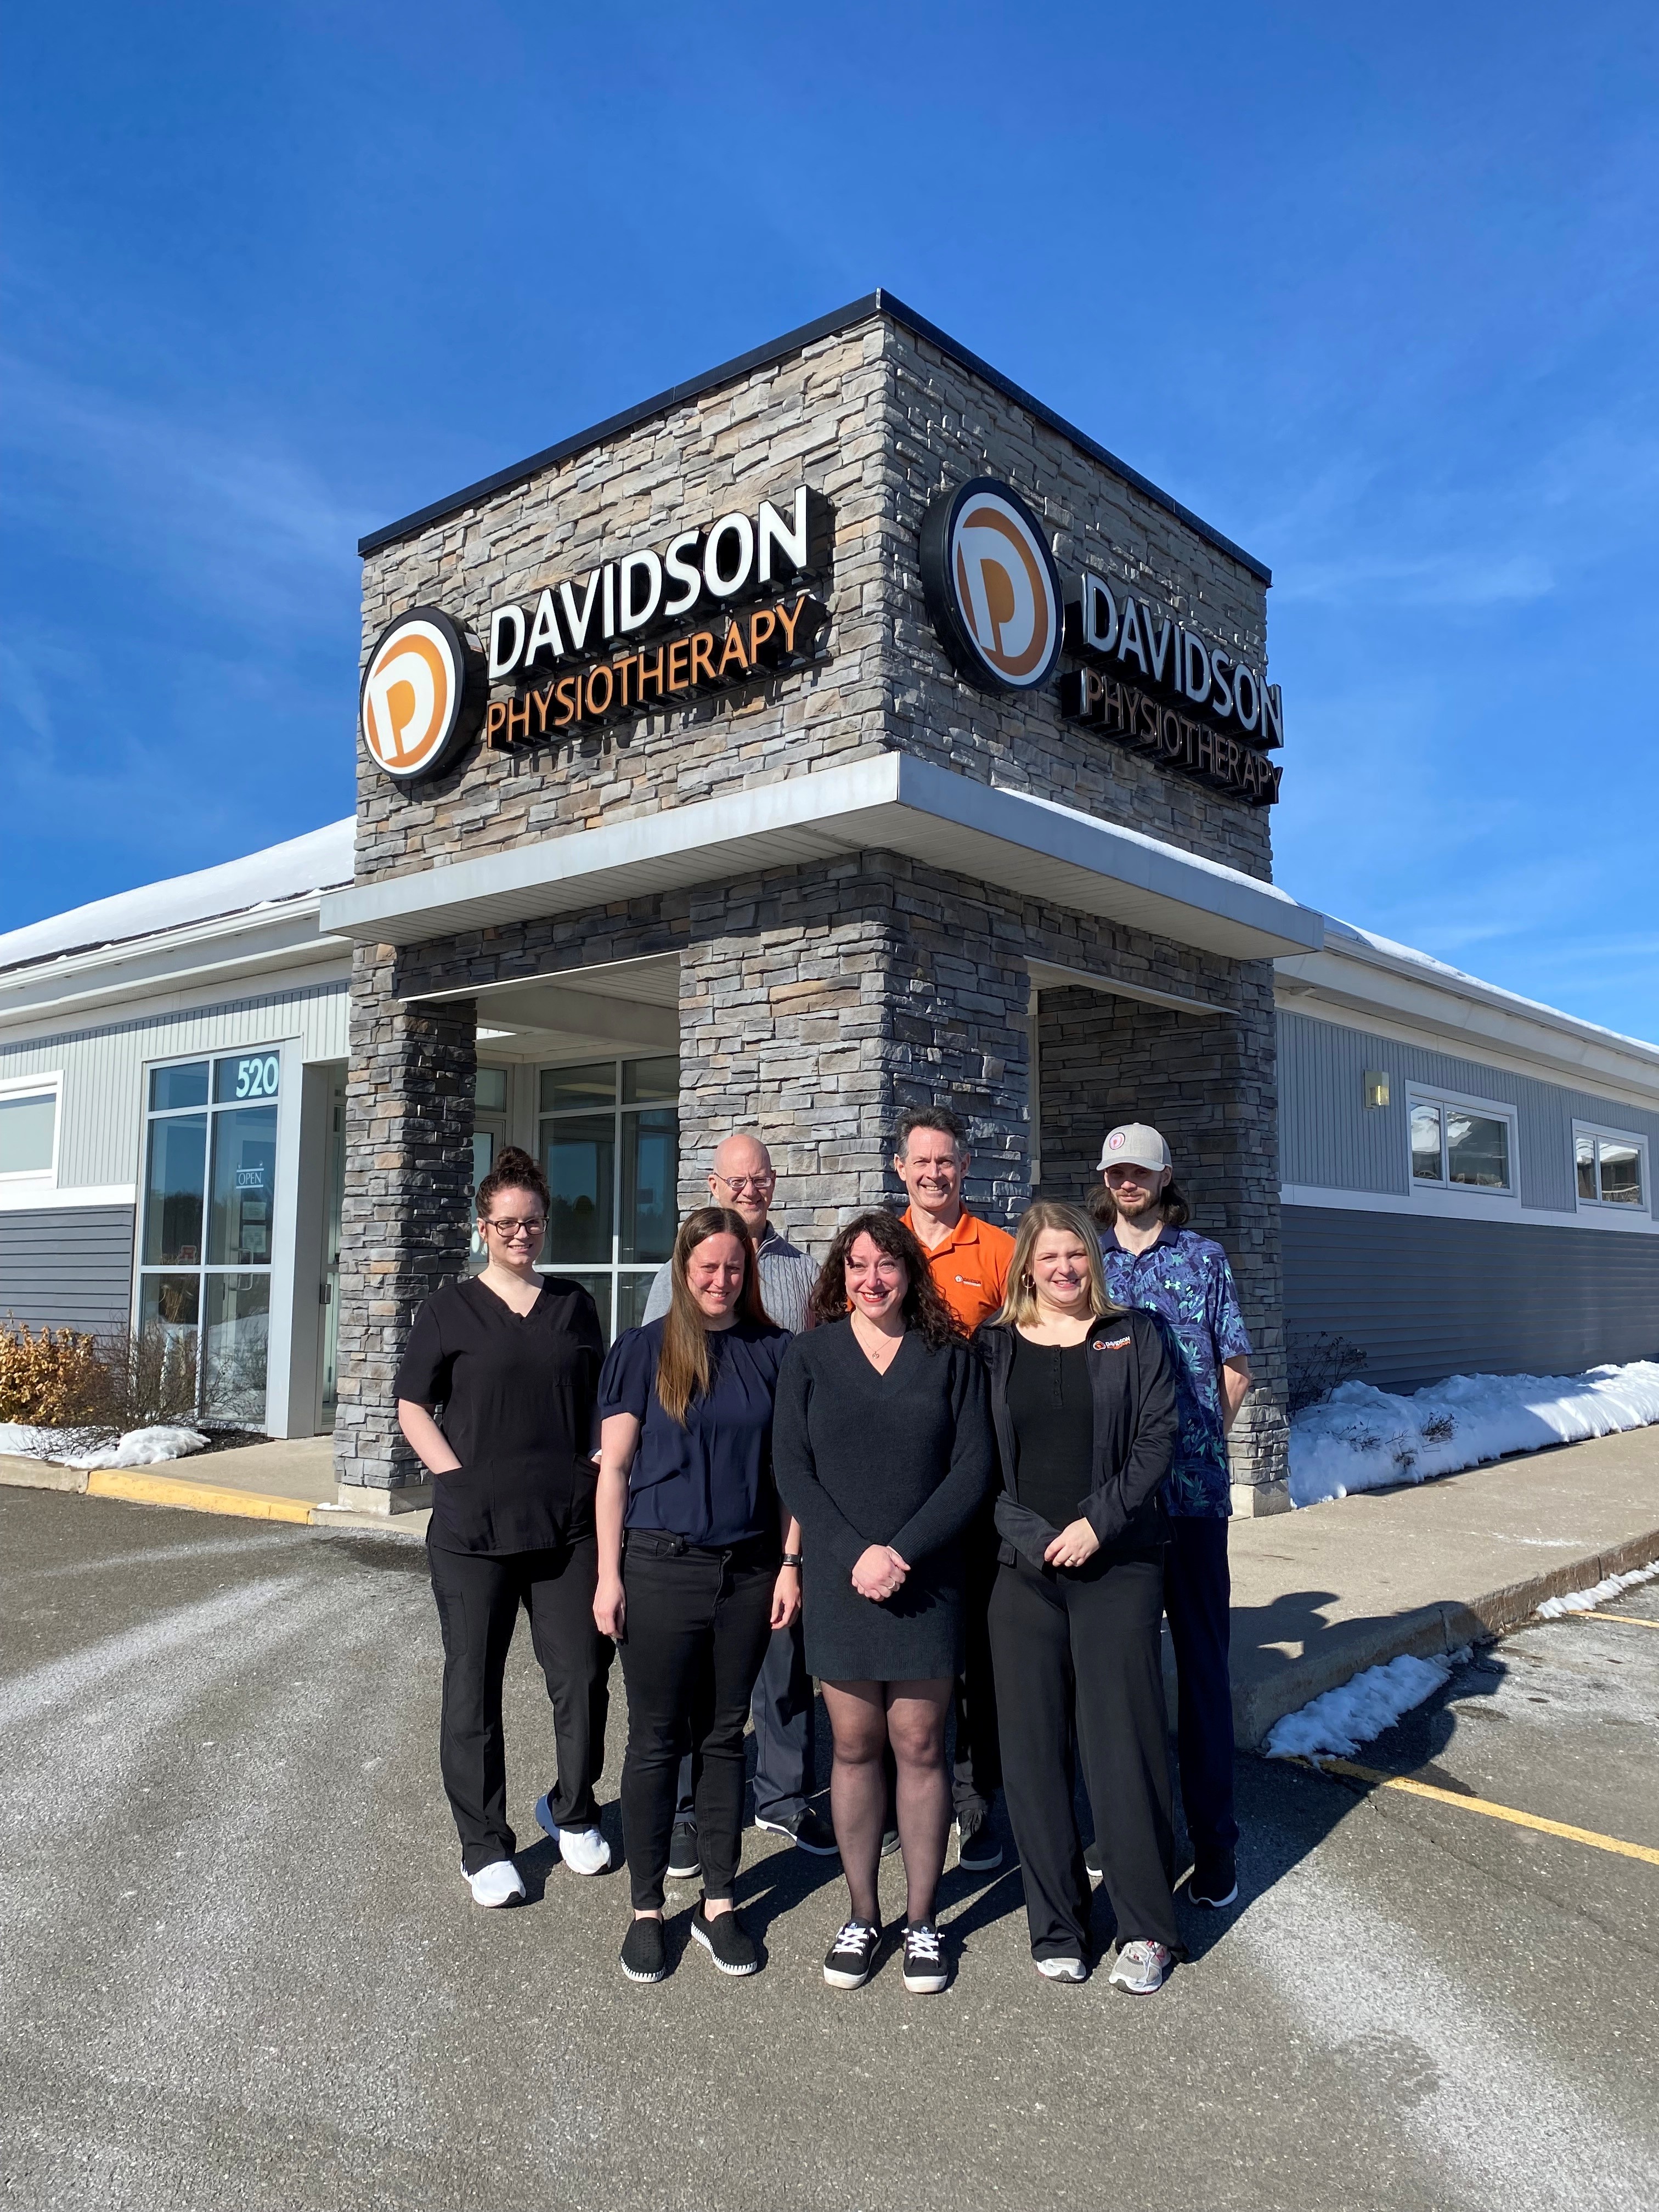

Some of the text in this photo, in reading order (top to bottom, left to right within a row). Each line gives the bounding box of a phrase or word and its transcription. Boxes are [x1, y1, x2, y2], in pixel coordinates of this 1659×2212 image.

[488, 484, 808, 680] DAVIDSON
[487, 596, 806, 749] PHYSIOTHERAPY
[1084, 571, 1284, 748] DAVIDSON
[1083, 667, 1284, 804] PHYSIOTHERAPY
[236, 1056, 279, 1098] 520
[238, 1172, 262, 1186] OPEN
